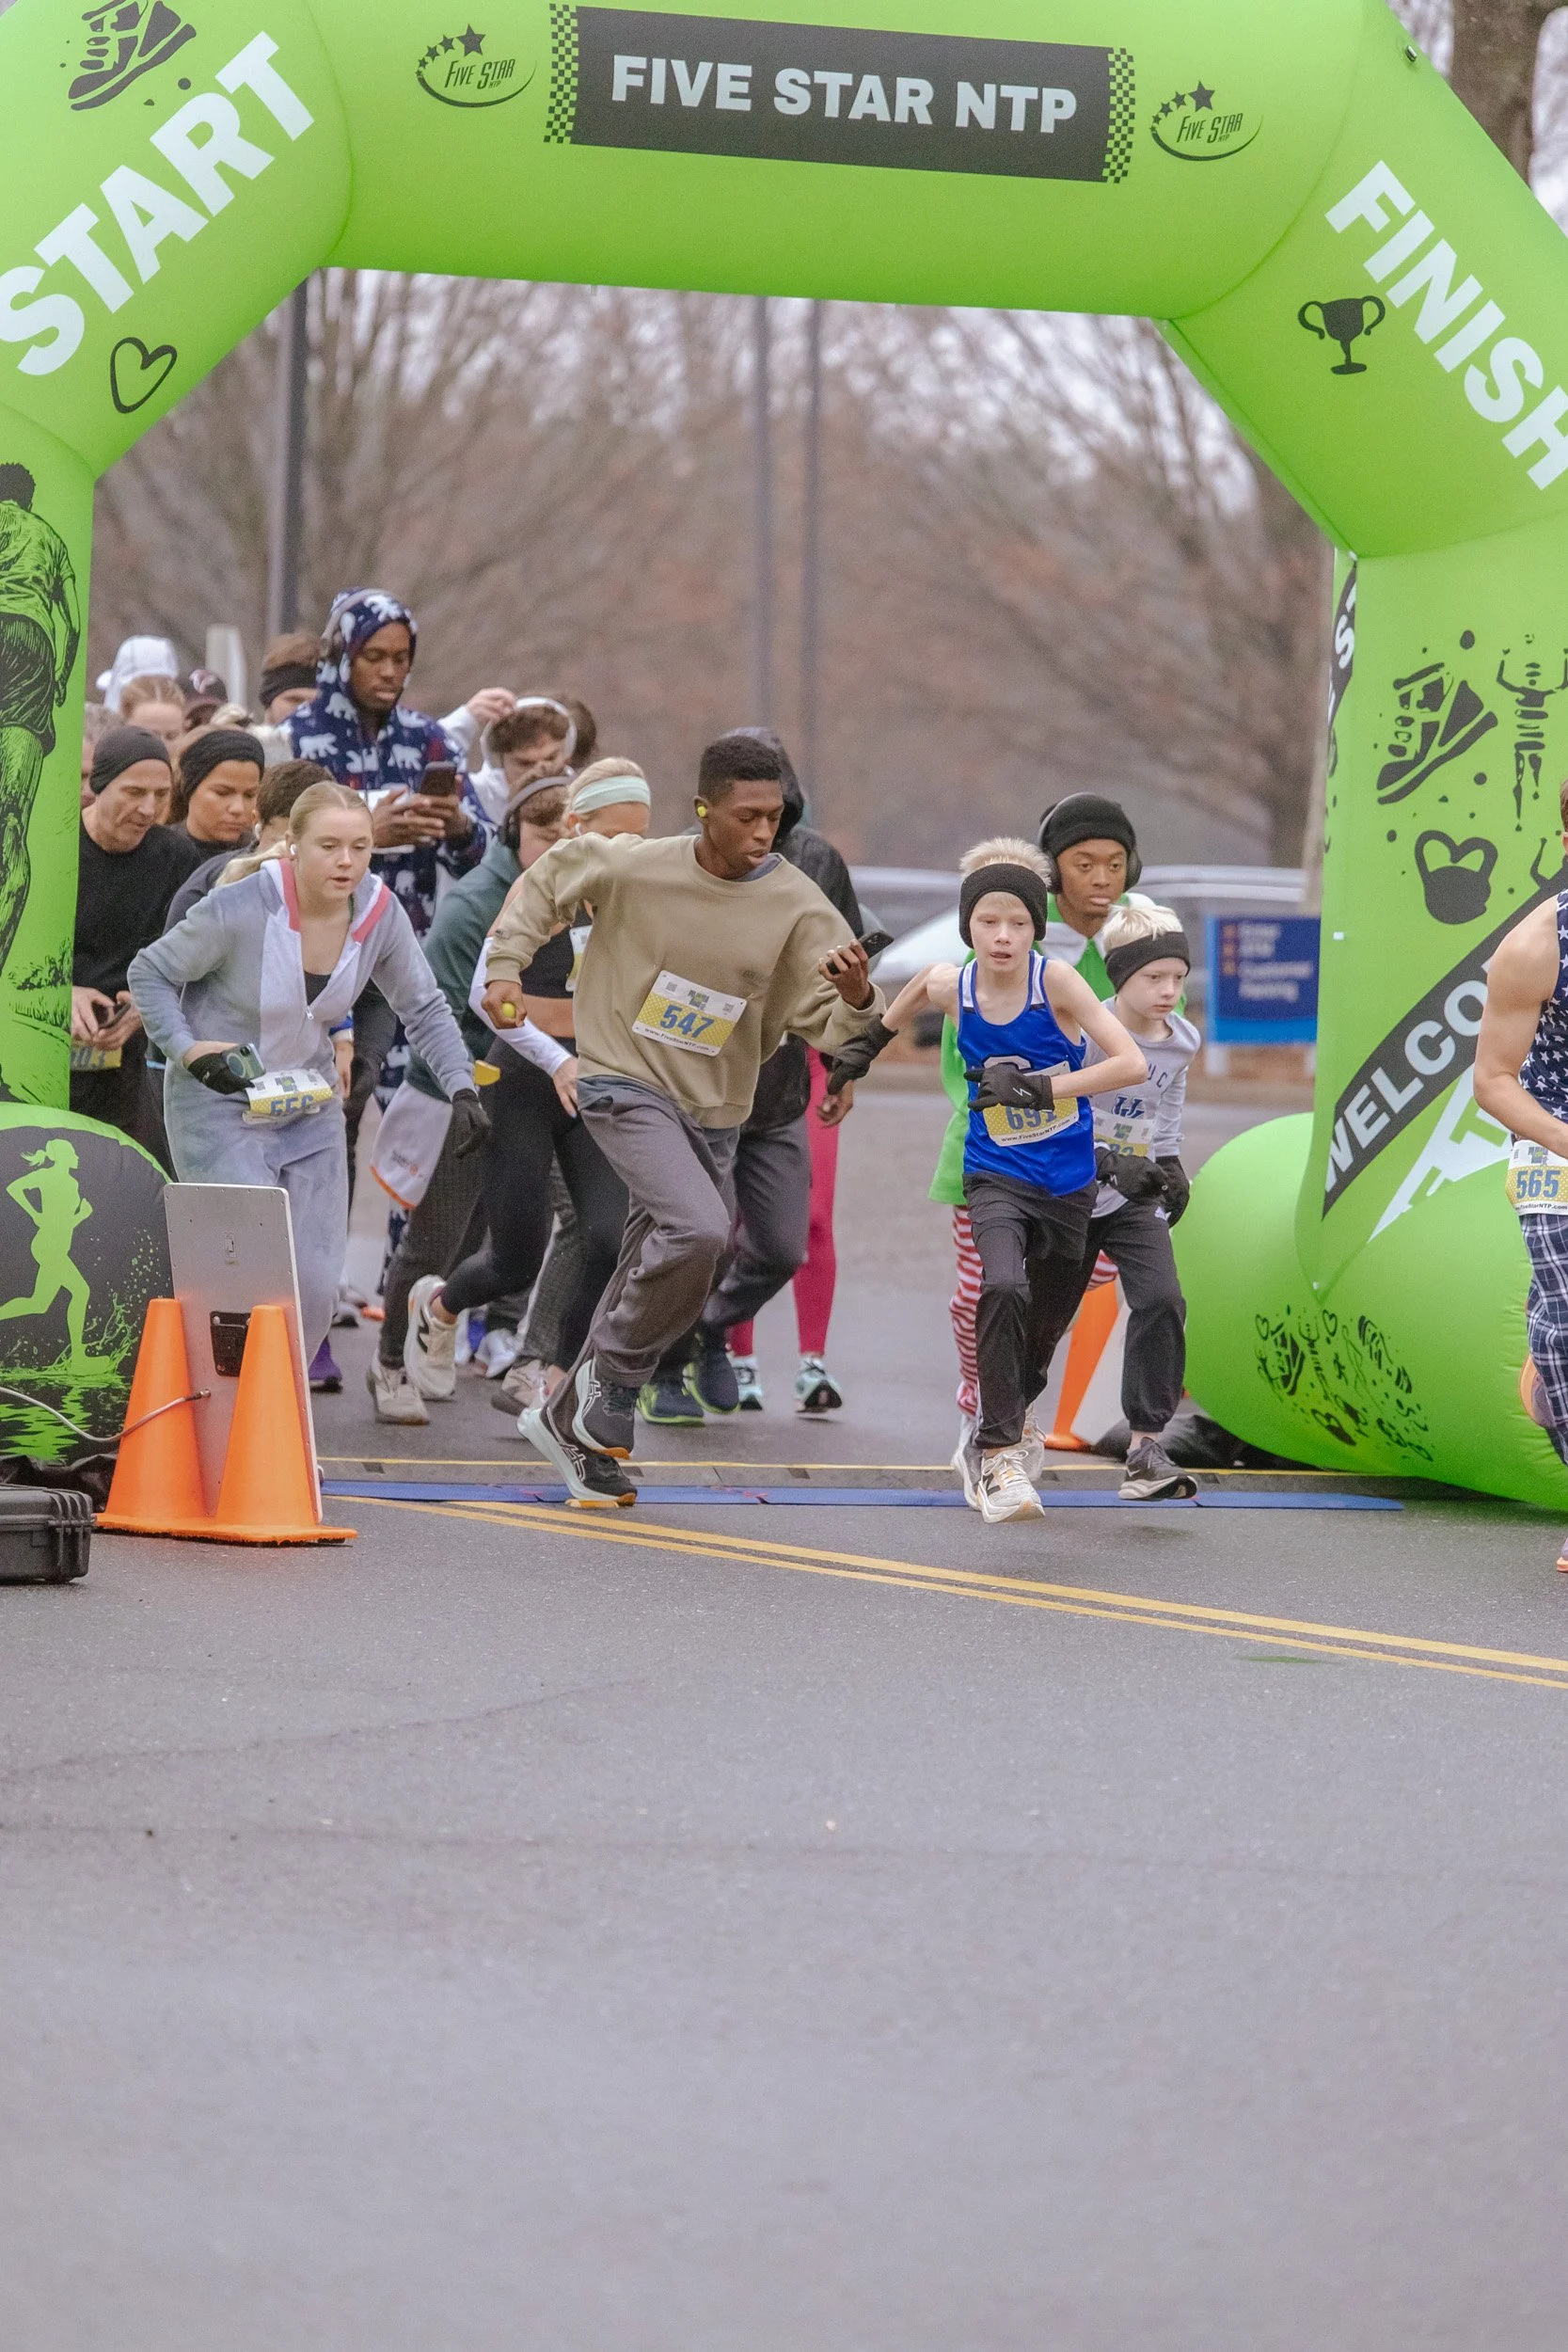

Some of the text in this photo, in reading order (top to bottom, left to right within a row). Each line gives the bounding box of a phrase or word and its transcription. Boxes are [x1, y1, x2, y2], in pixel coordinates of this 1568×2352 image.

[444, 58, 515, 89] FIVE STAR
[611, 55, 1077, 134] FIVE STAR NTP
[1176, 113, 1243, 143] FIVE STAR
[0, 31, 315, 375] START
[1323, 159, 1568, 491] FINISH
[659, 1005, 715, 1039] 547
[1324, 961, 1493, 1193] WELCO
[1001, 1119, 1070, 1142] www.FiveStarNTP.com
[1516, 1169, 1560, 1200] 565
